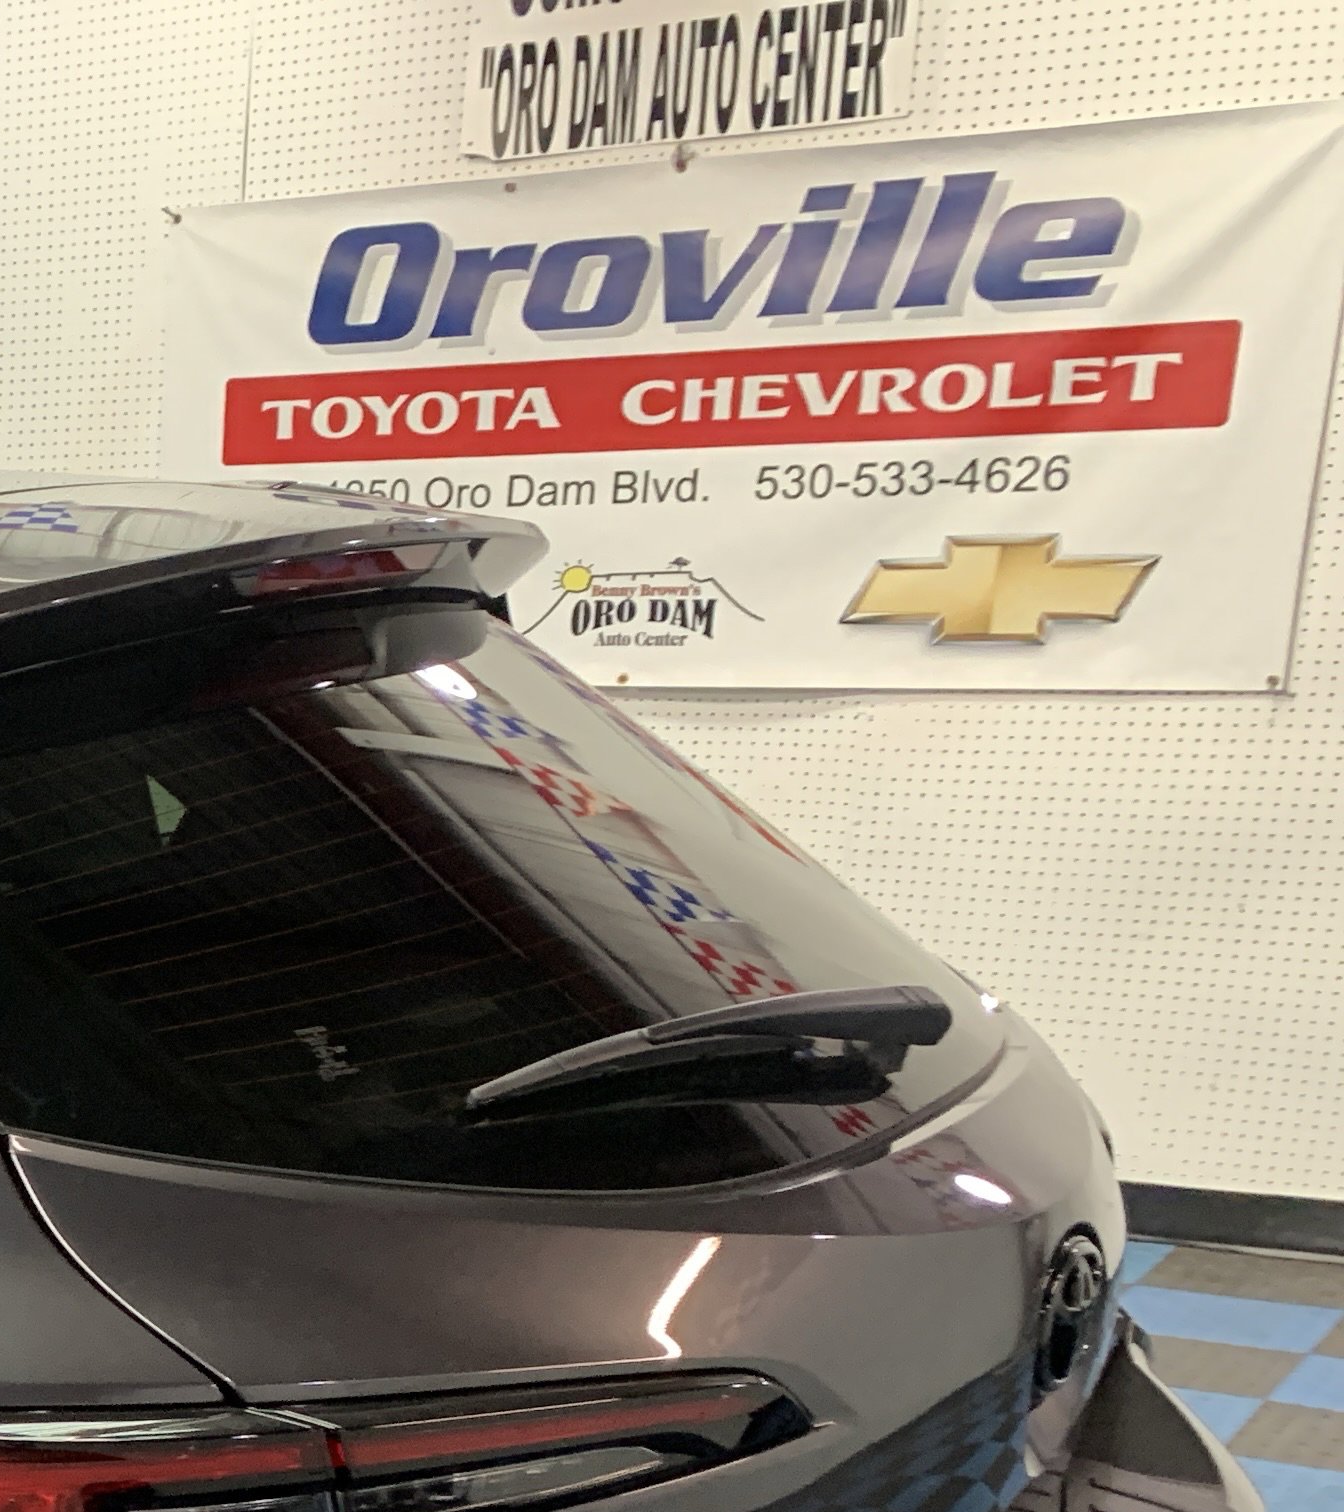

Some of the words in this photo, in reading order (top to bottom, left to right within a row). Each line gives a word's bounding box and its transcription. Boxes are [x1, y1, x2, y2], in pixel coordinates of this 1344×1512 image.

[481, 37, 561, 159] "ORO
[567, 27, 643, 150] DAM
[646, 13, 742, 142] AUTO
[309, 171, 1129, 352] Oroville
[261, 386, 562, 443] TOYOTA
[622, 351, 1184, 426] CHEVROLET
[330, 478, 411, 504] 50
[424, 476, 492, 509] Oro
[507, 473, 596, 507] Dam
[612, 467, 711, 504] Blvd.
[754, 454, 1071, 500] 530-533-4626
[591, 584, 638, 599] Benny
[640, 583, 702, 597] Brown's
[570, 599, 637, 636] ORO
[647, 598, 718, 640] DAM
[594, 631, 631, 647] Auto
[634, 631, 689, 647] Center
